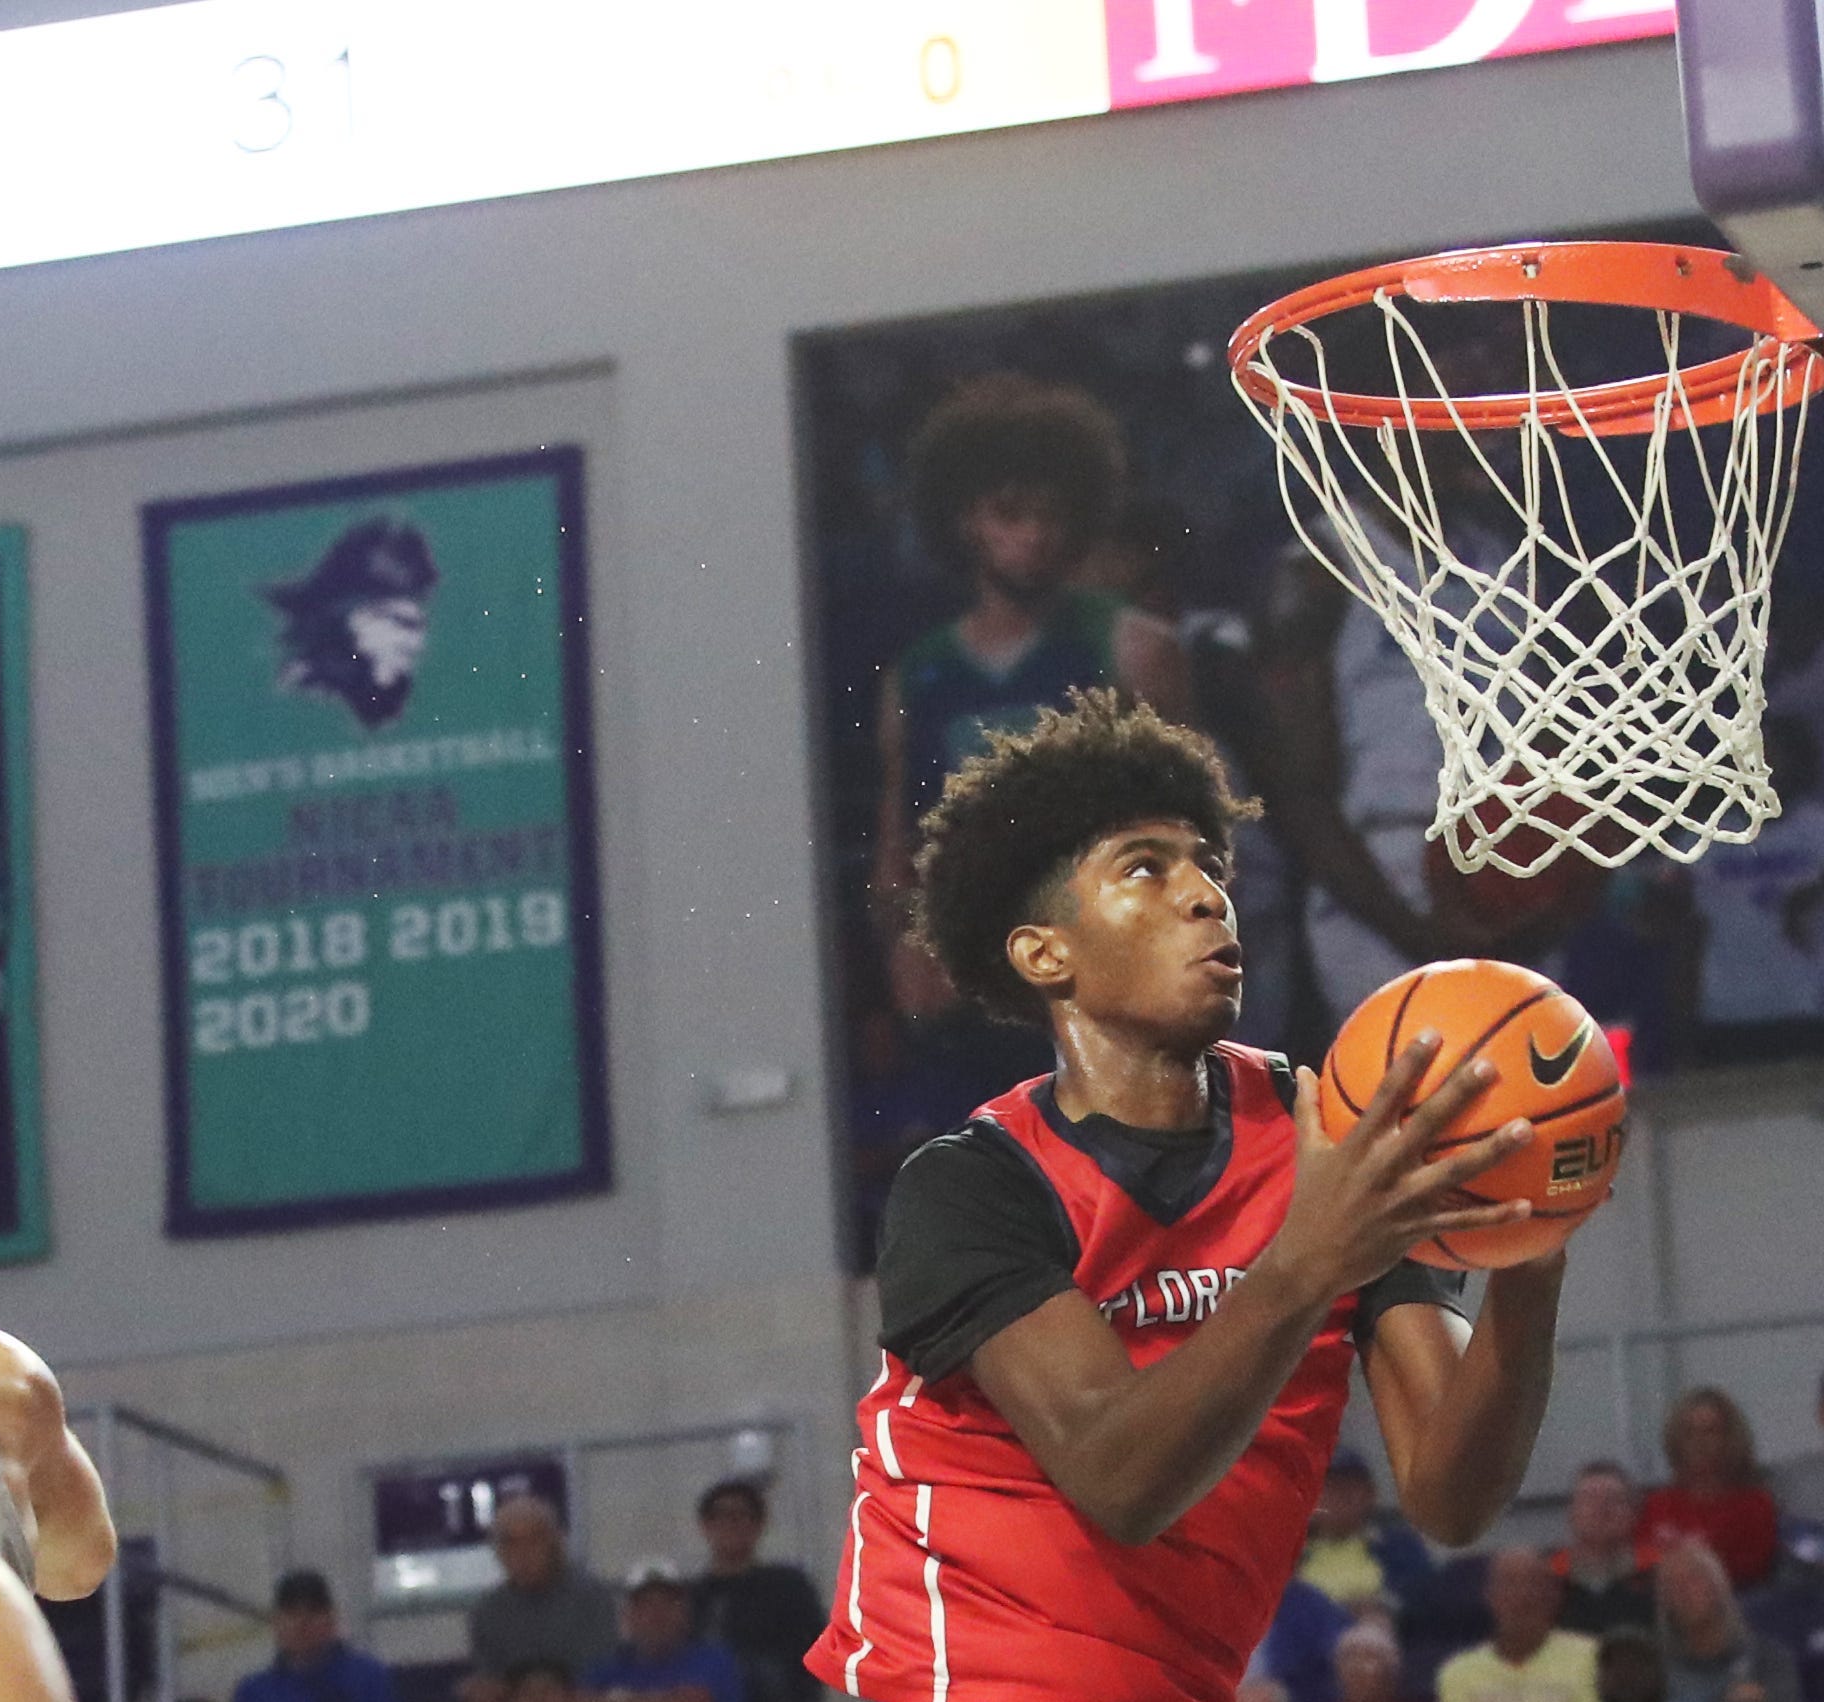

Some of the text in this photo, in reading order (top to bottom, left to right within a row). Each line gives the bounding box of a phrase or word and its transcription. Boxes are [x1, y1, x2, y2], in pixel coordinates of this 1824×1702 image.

[231, 46, 356, 153] 31
[192, 891, 567, 985] 2018 2019
[194, 979, 371, 1055] 2020
